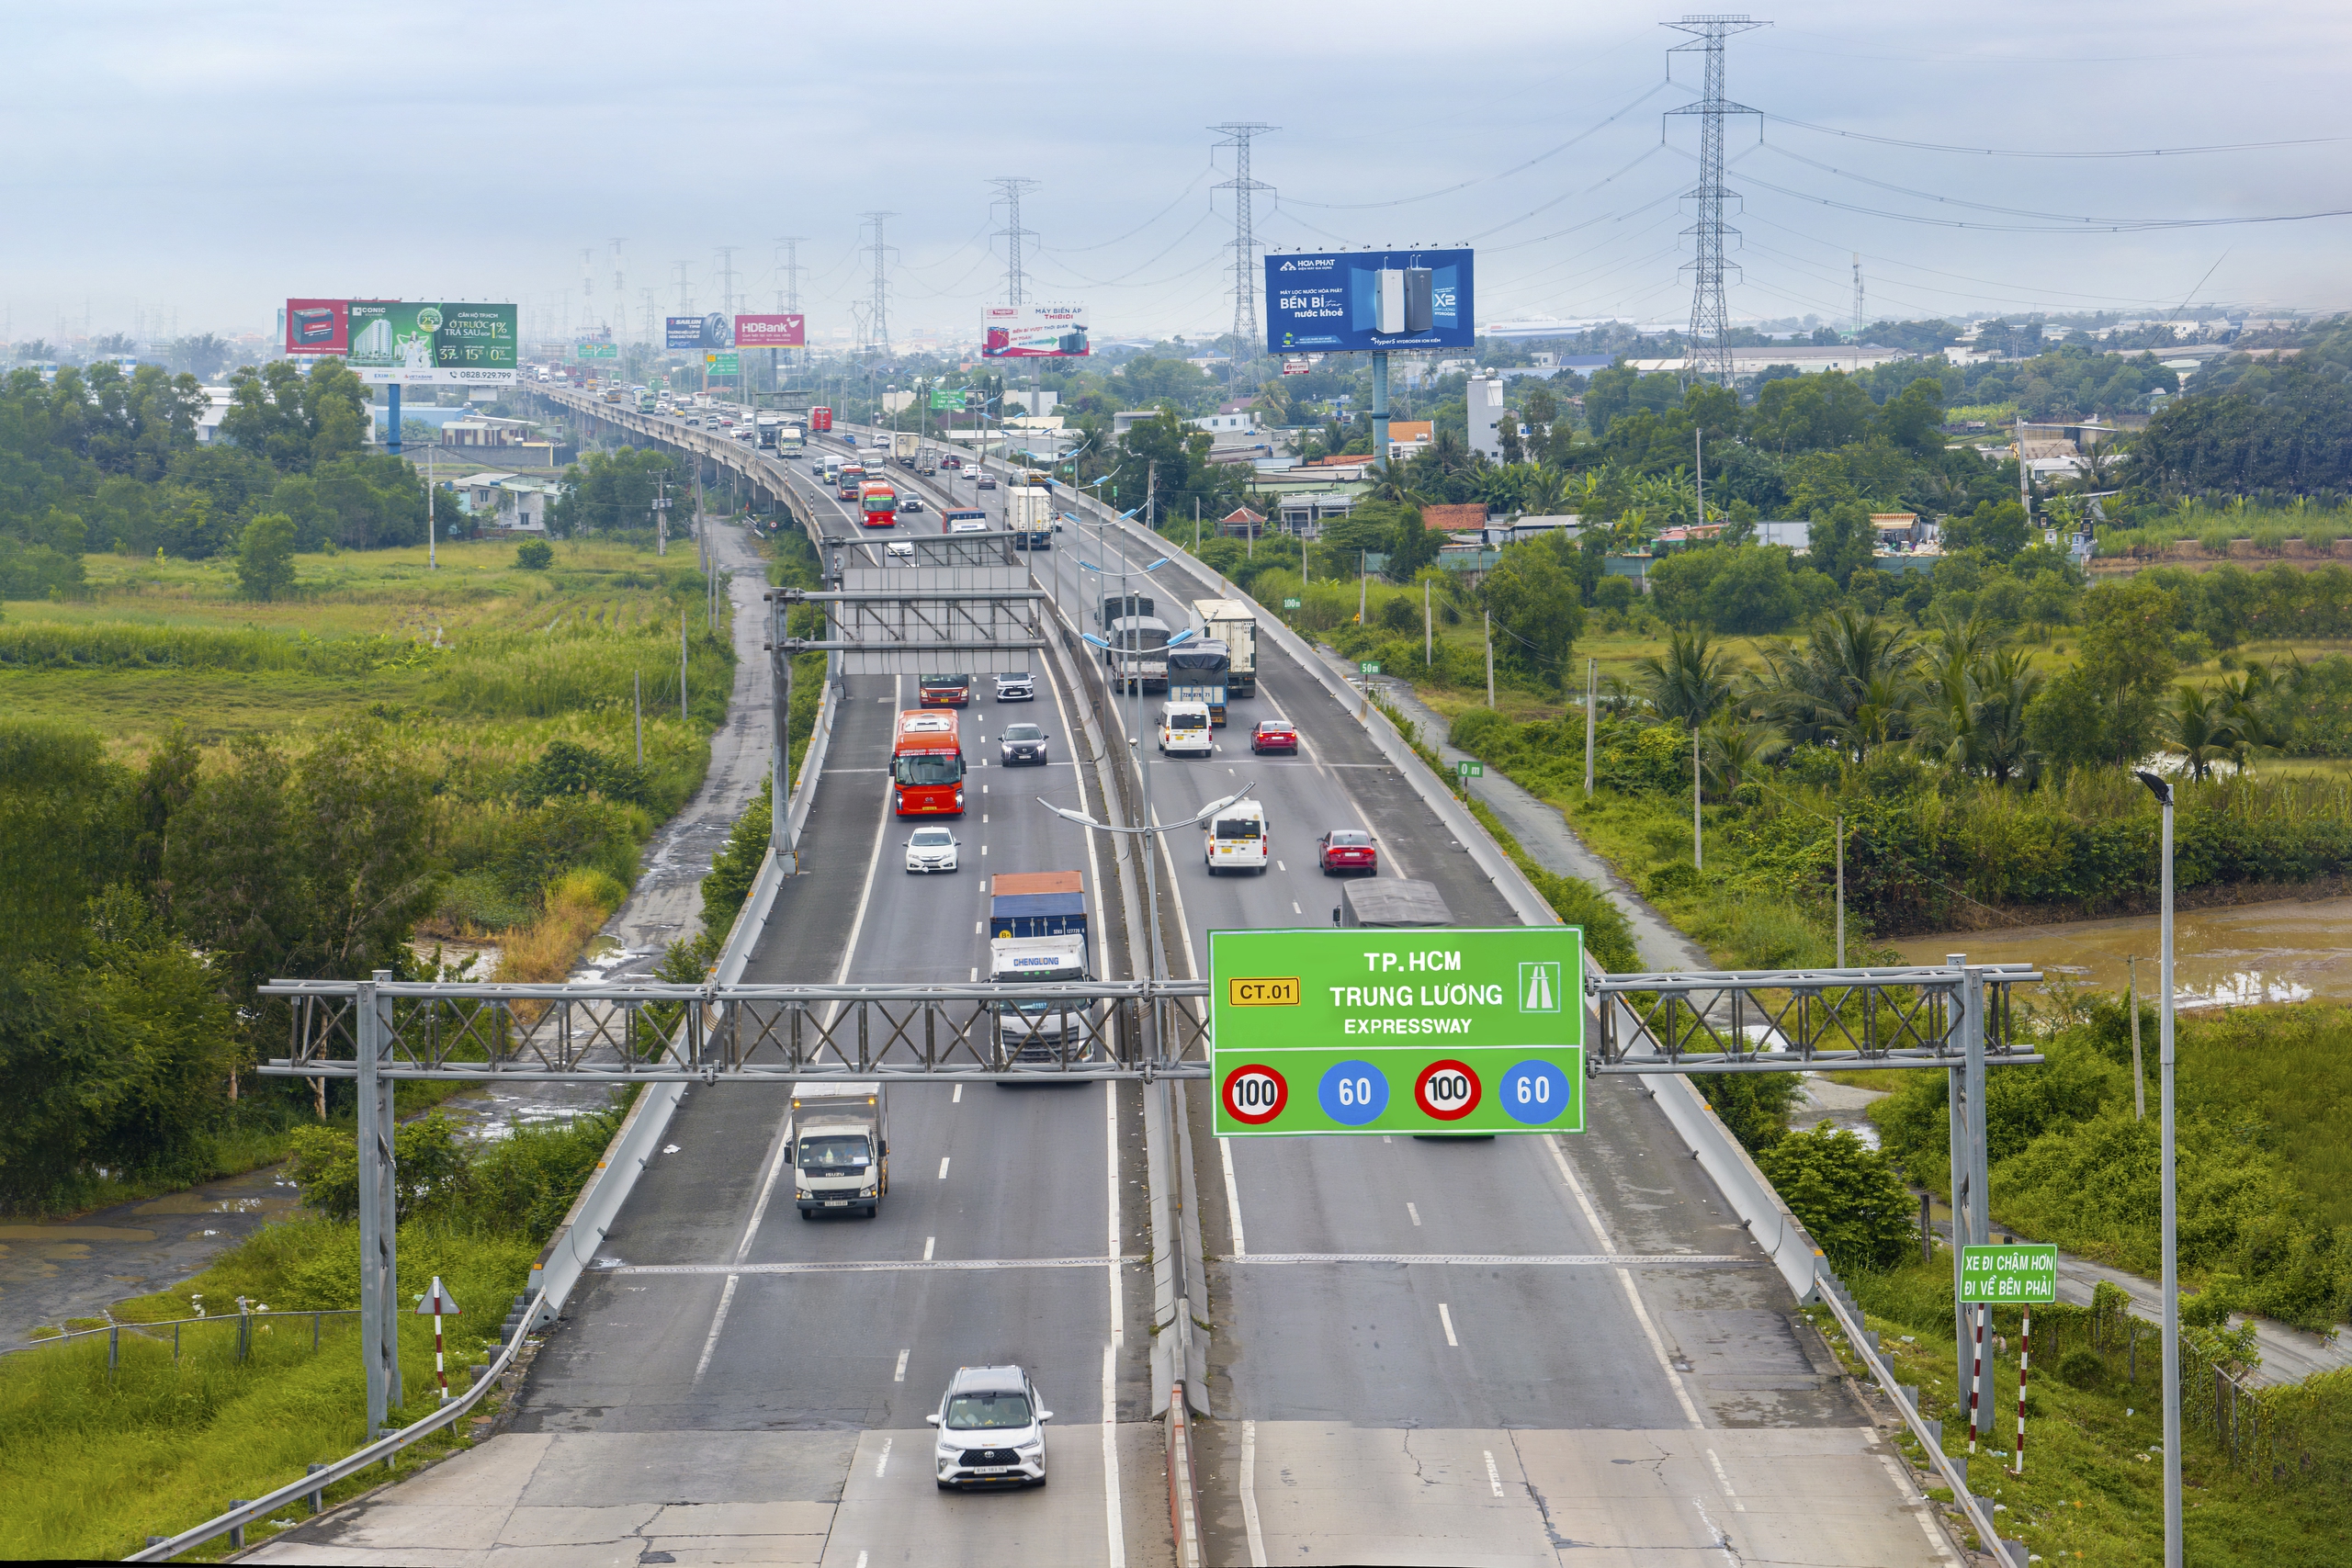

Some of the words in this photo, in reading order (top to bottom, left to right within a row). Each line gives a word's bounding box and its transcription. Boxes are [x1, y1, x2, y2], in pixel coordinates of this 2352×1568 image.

[1434, 293, 1456, 307] X2
[1295, 309, 1318, 318] nước
[458, 320, 489, 328] TRƯỚC
[742, 323, 787, 332] HDBank
[444, 327, 462, 336] TRẢ
[465, 349, 483, 360] 15%
[491, 349, 506, 360] 0%
[1284, 599, 1300, 607] 100m
[1362, 664, 1378, 673] 50m
[1014, 957, 1059, 966] CHENGLONG
[1363, 950, 1462, 972] TP.HCM
[1240, 984, 1291, 1000] CT.01
[1329, 986, 1413, 1006] TRUNG
[1421, 982, 1503, 1006] LƯƠNG
[1344, 1018, 1472, 1034] EXPRESSWAY
[1235, 1079, 1275, 1107] 100
[1338, 1078, 1371, 1106] 60
[1428, 1076, 1467, 1101] 100
[1517, 1076, 1550, 1104] 60
[1966, 1256, 1980, 1271] XE
[1982, 1256, 1993, 1270] ĐI
[1997, 1252, 2029, 1273] CHẬM
[2031, 1254, 2053, 1271] HƠN
[1964, 1281, 1975, 1295] ĐI
[1980, 1275, 1997, 1295] VỀ
[1999, 1276, 2021, 1295] BÊN
[2025, 1275, 2051, 1295] PHẢI
